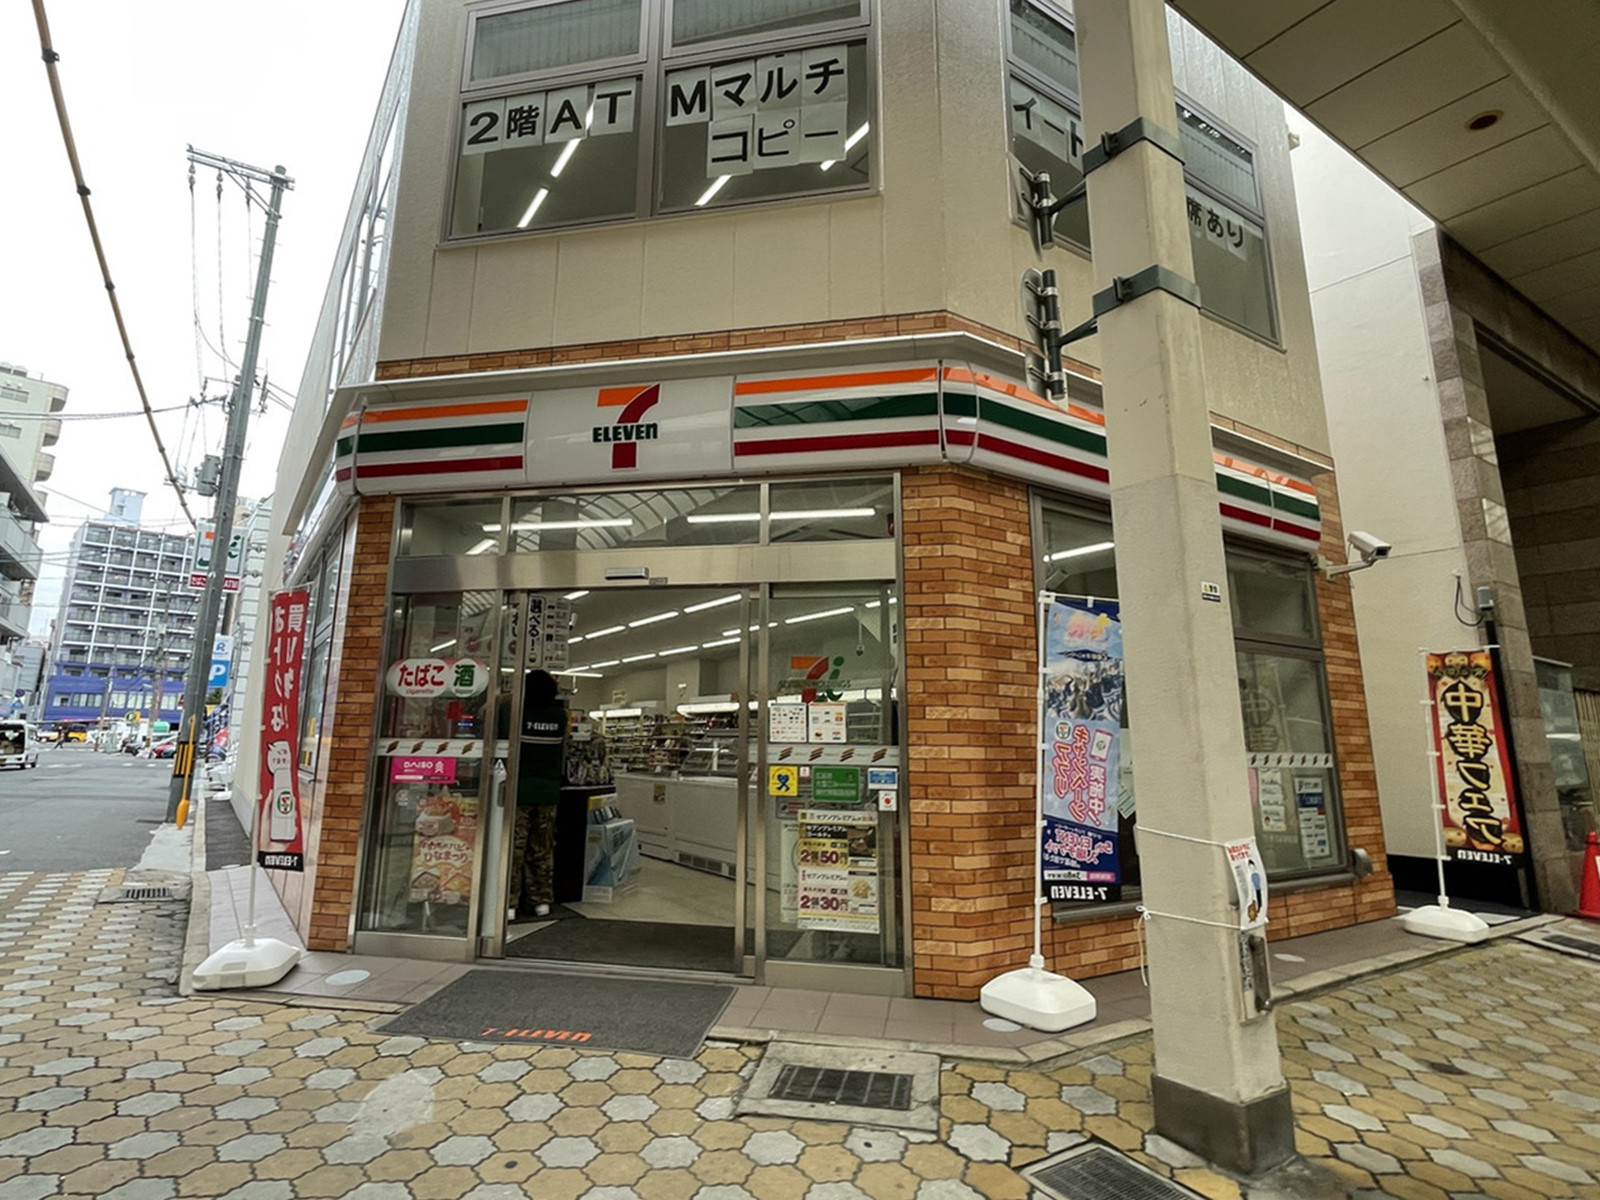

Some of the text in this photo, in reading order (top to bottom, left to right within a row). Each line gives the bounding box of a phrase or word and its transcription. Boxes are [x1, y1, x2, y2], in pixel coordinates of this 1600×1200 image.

[711, 119, 839, 163] コピー
[208, 664, 227, 681] P
[398, 664, 476, 687] たばこ 酒
